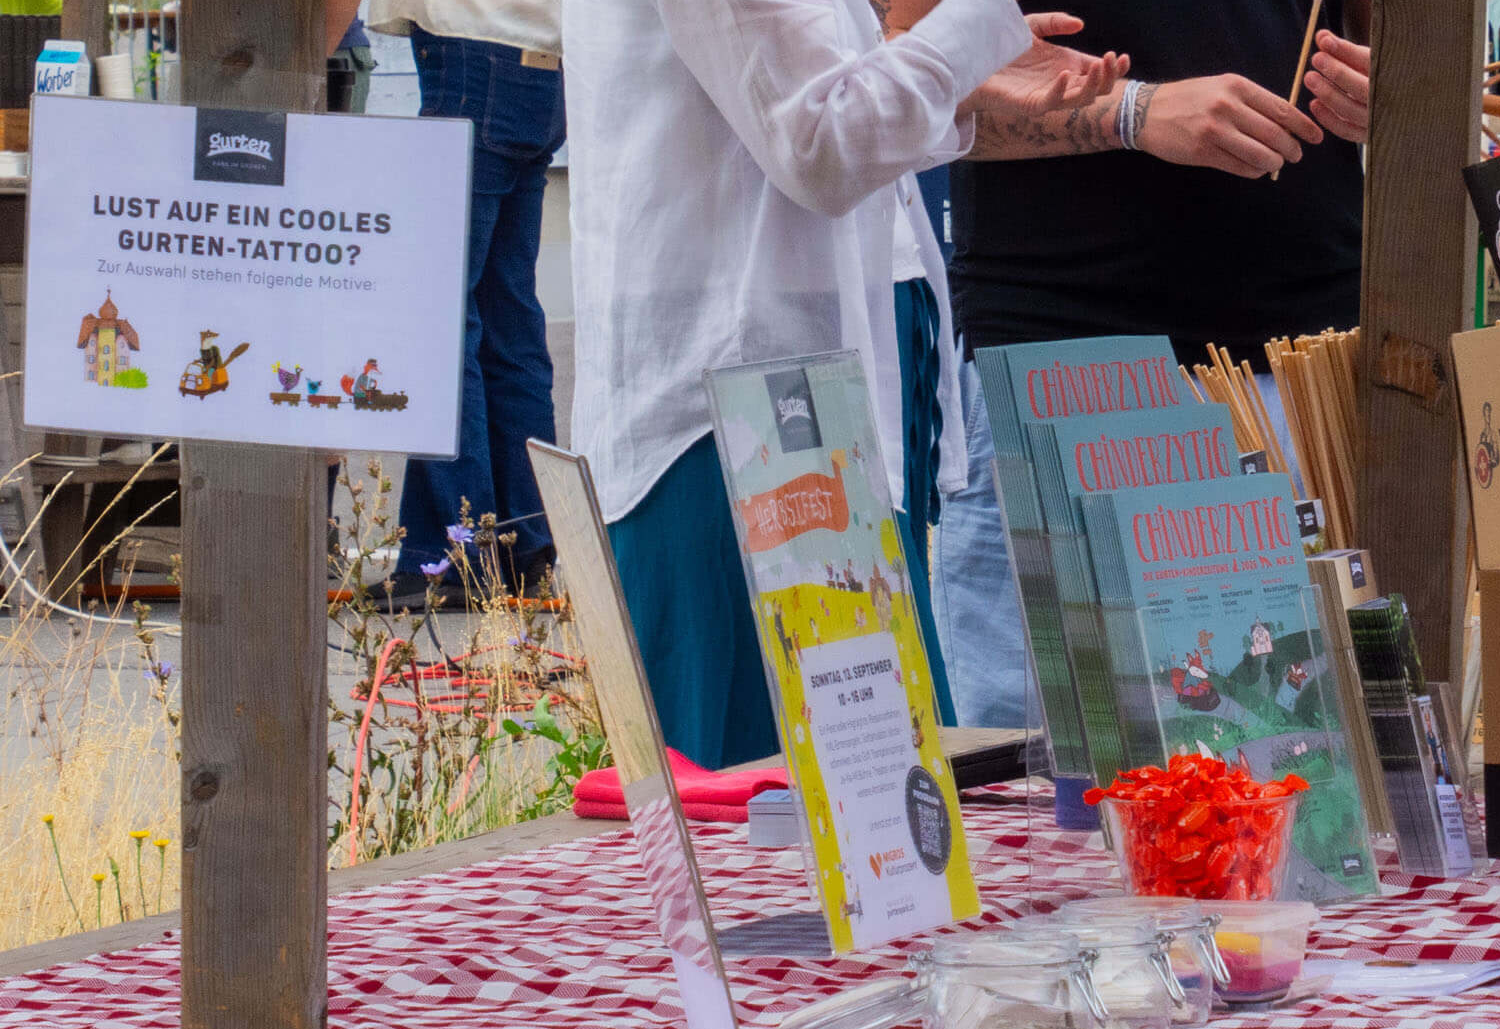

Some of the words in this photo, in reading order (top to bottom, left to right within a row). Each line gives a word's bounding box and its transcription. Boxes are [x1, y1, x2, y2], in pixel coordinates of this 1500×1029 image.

[207, 131, 272, 157] gurten
[93, 194, 161, 219] LUST
[167, 200, 219, 223] AUF
[227, 204, 270, 228] EIN
[279, 207, 392, 234] COOLES
[118, 229, 362, 266] GURTEN-TATTOO?
[97, 259, 121, 273] Zur
[125, 261, 187, 278] Auswahl
[191, 267, 242, 283] stehen
[247, 270, 313, 289] folgende
[319, 275, 377, 292] Motive:
[852, 659, 894, 680] SEPTEMBER
